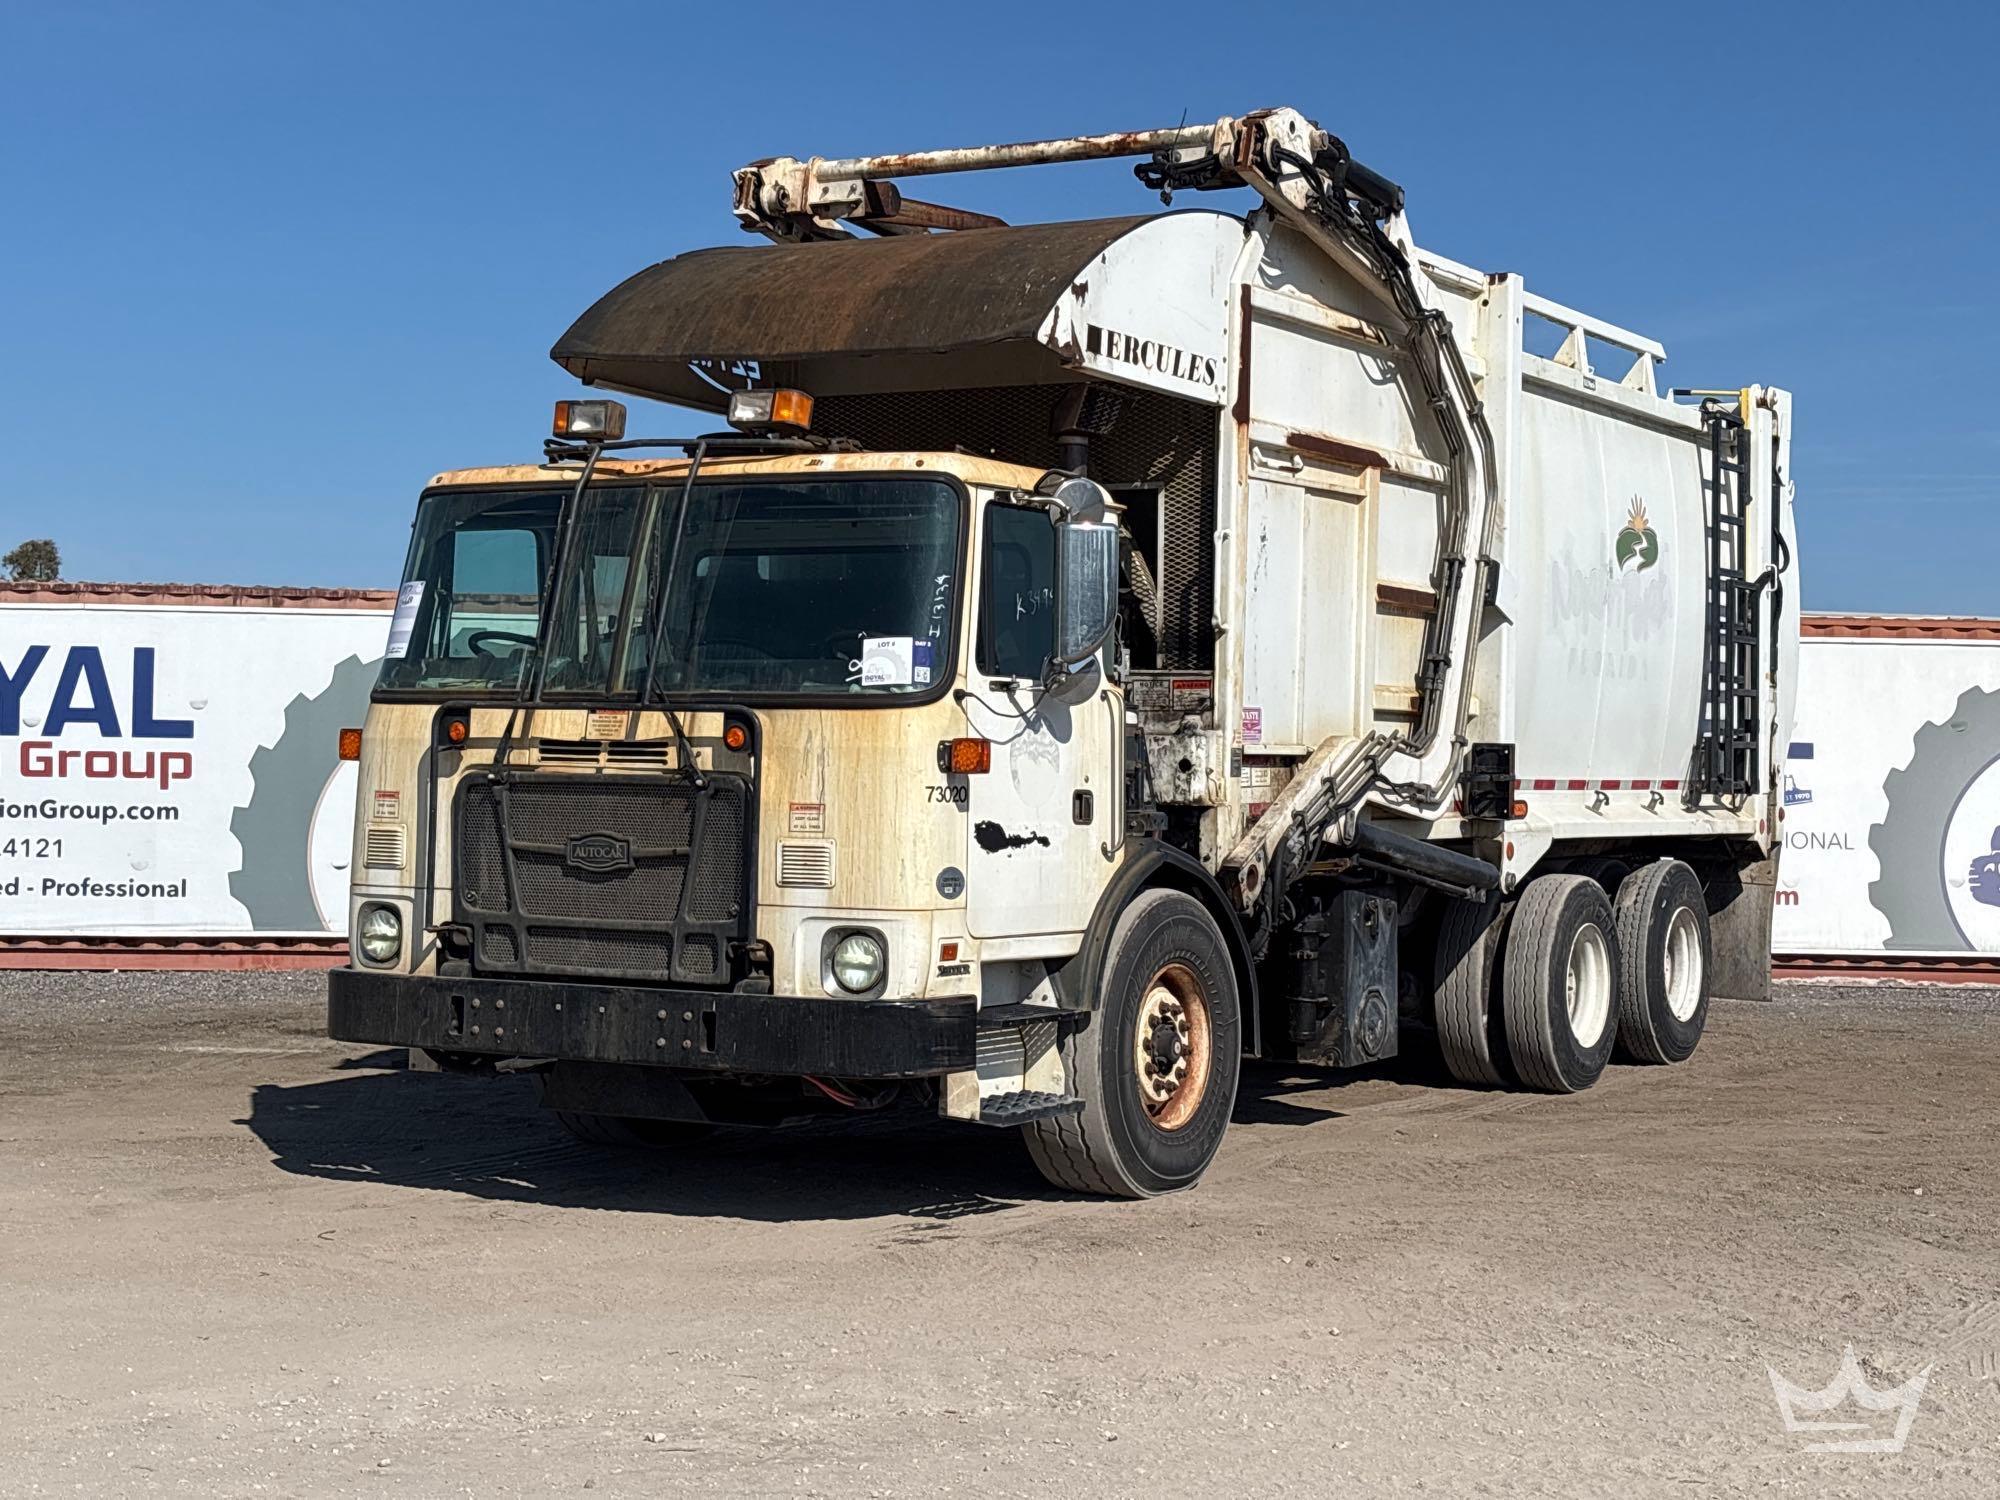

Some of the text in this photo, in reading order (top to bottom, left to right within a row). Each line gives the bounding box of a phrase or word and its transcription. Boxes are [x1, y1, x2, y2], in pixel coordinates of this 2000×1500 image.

[20, 741, 192, 789] Group
[925, 785, 967, 803] 73020
[0, 798, 179, 824] ionGroup.com
[0, 838, 62, 858] 4121
[1785, 832, 1855, 850] IONAL
[574, 846, 624, 859] AUTOCAR
[0, 876, 19, 896] d
[42, 878, 187, 898] Professional
